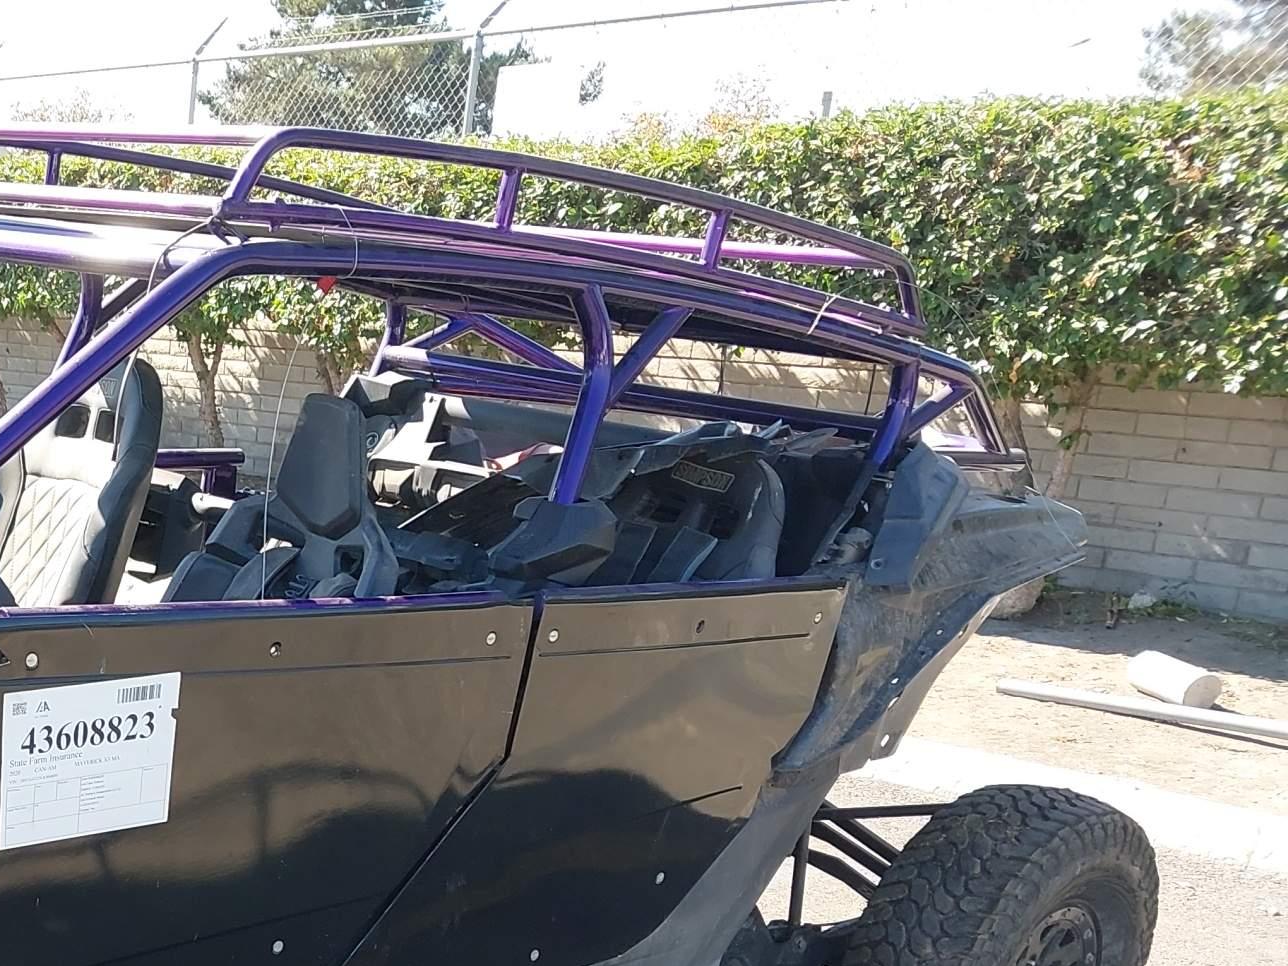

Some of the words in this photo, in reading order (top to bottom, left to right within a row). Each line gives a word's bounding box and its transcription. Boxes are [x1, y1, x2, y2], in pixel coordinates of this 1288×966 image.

[21, 711, 155, 755] 43608823
[9, 758, 27, 769] State
[29, 756, 48, 766] Farm
[49, 752, 83, 763] Insurance
